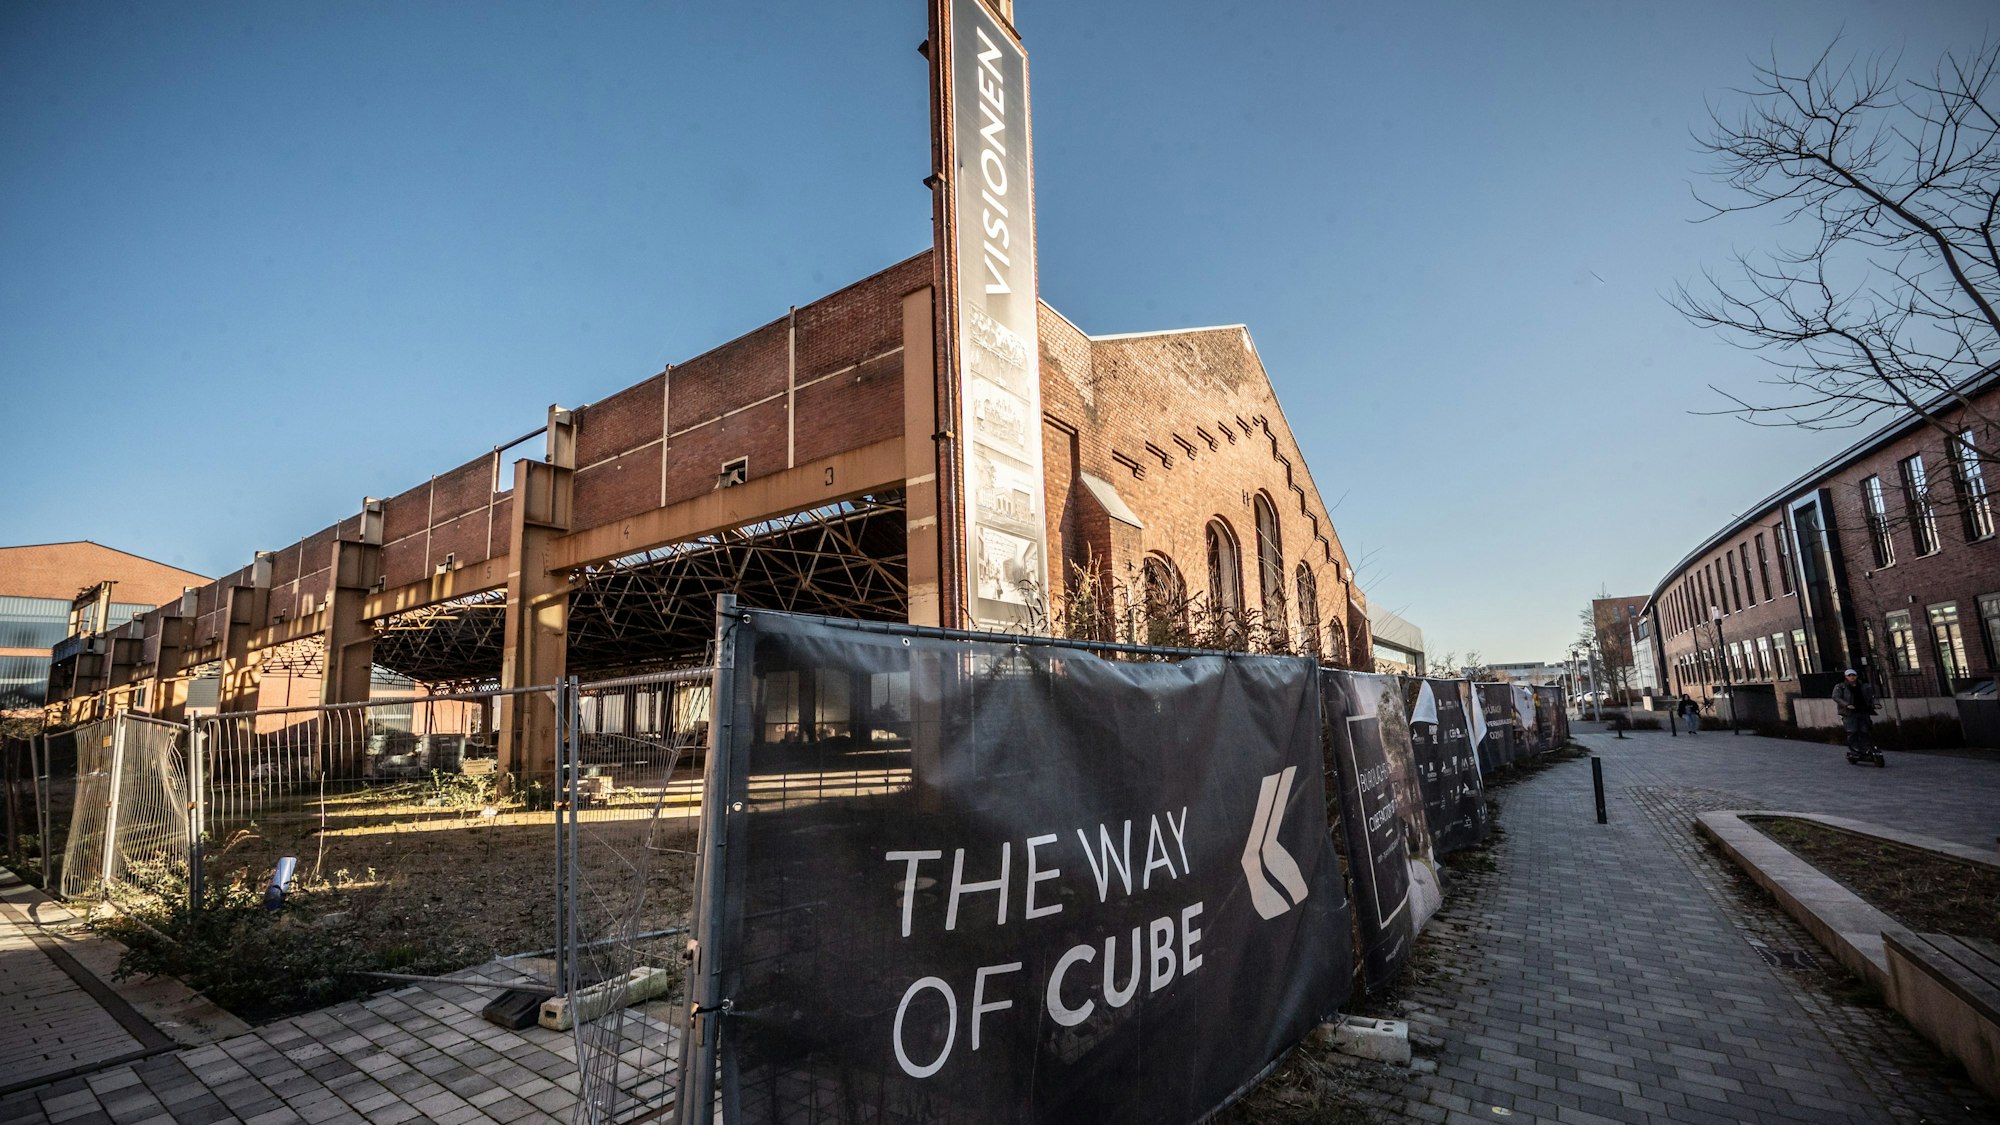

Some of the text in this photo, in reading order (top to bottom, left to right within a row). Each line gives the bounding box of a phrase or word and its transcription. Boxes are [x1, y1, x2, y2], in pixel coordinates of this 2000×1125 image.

[976, 26, 1011, 294] VISIONEN
[825, 467, 834, 486] 3
[885, 806, 1190, 937] THE WAY
[893, 901, 1203, 1079] OF CUBE
